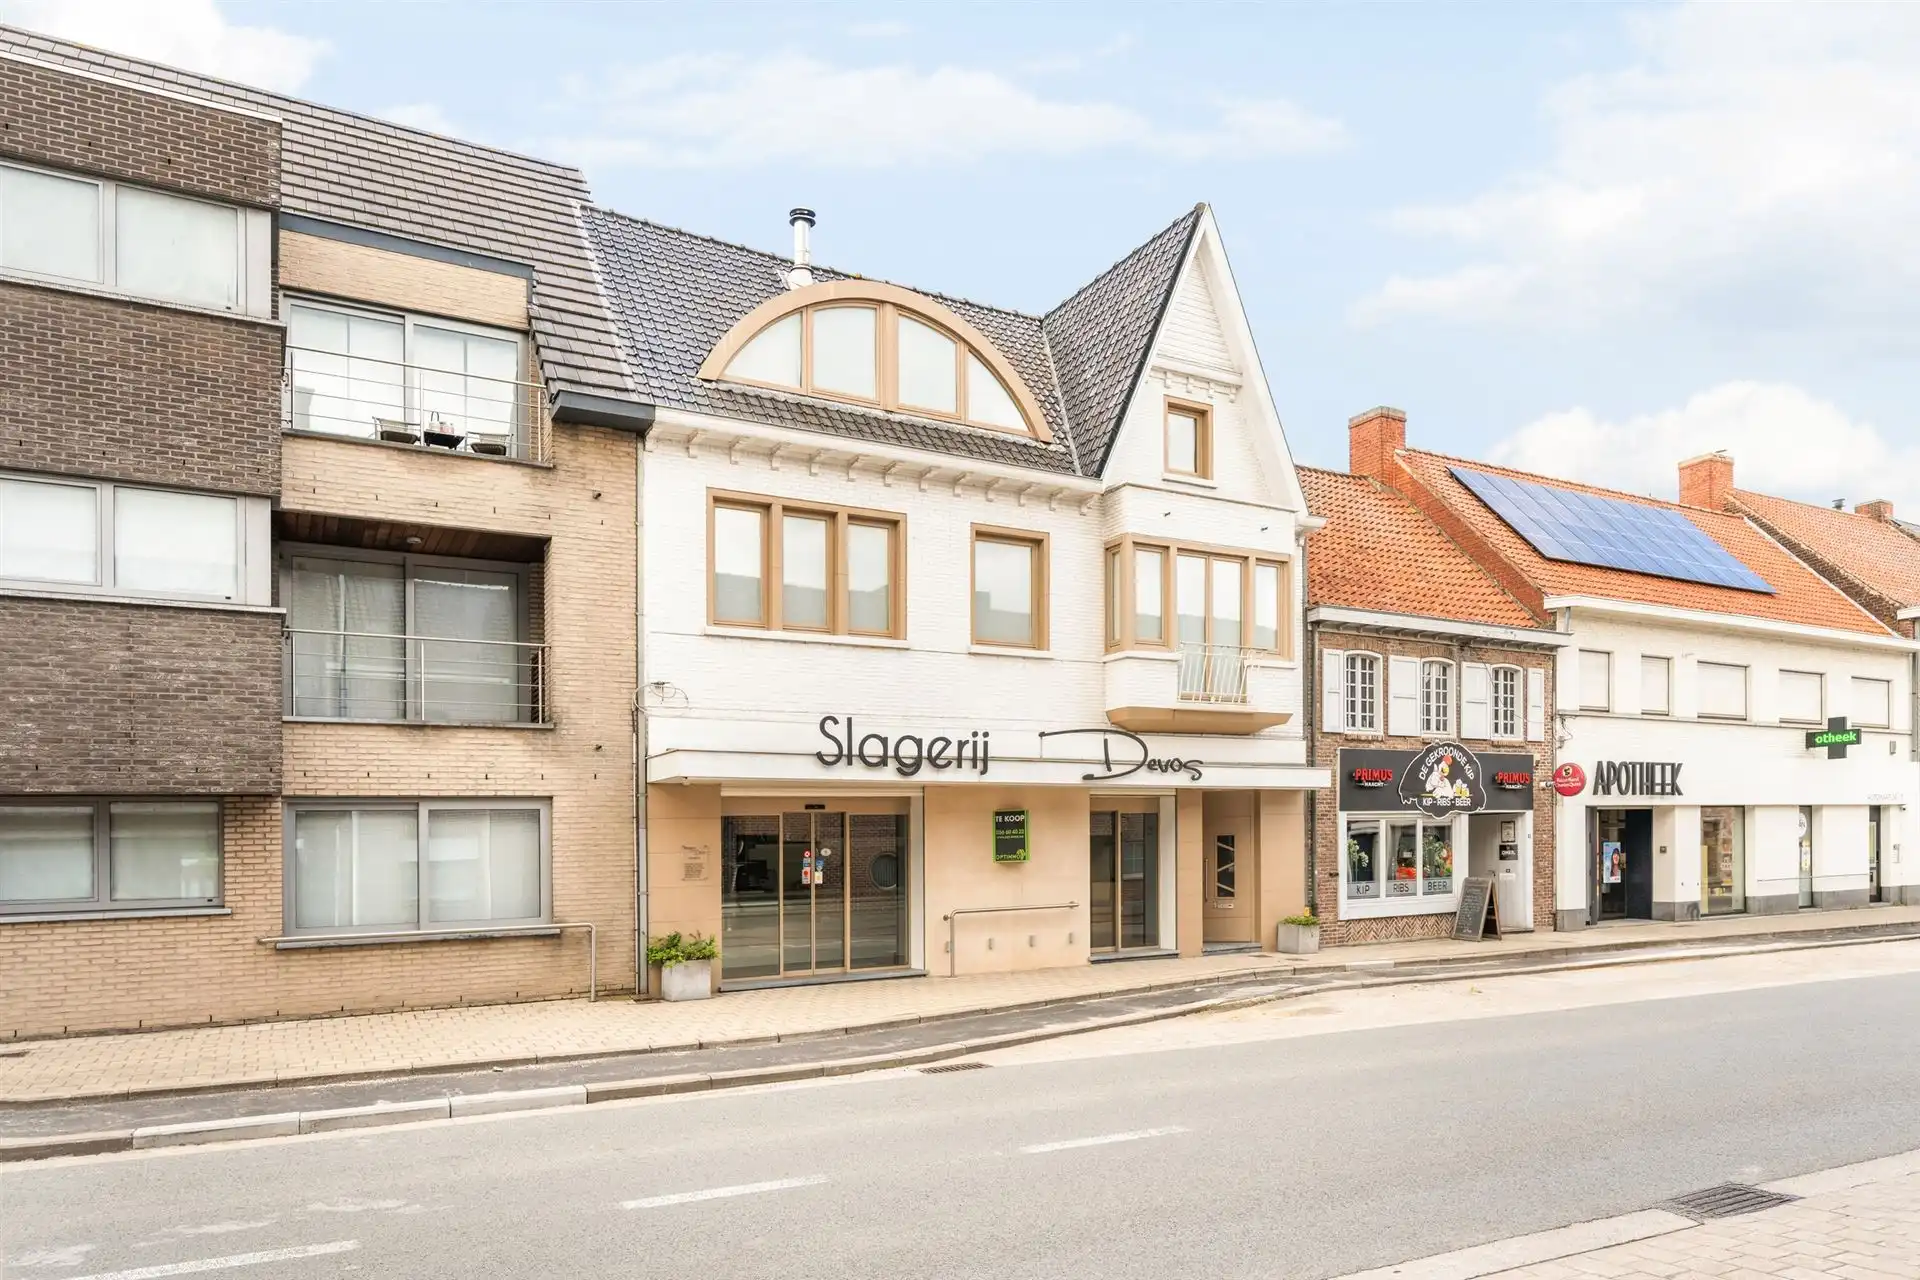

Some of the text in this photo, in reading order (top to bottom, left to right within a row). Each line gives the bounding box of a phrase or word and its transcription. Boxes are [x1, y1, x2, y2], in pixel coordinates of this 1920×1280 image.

[1815, 731, 1857, 743] otheek
[815, 715, 1203, 781] Slagerij Devos
[1419, 746, 1475, 780] DE GEKROONDE KIP
[1355, 768, 1393, 782] PRIMUS
[1497, 771, 1531, 784] PRIMUS
[1592, 760, 1684, 796] APOTHEEK
[1422, 797, 1471, 806] KIP RIBS BEER
[1356, 884, 1370, 895] KIP
[1393, 883, 1410, 893] RIBS
[1427, 881, 1448, 891] BEER
